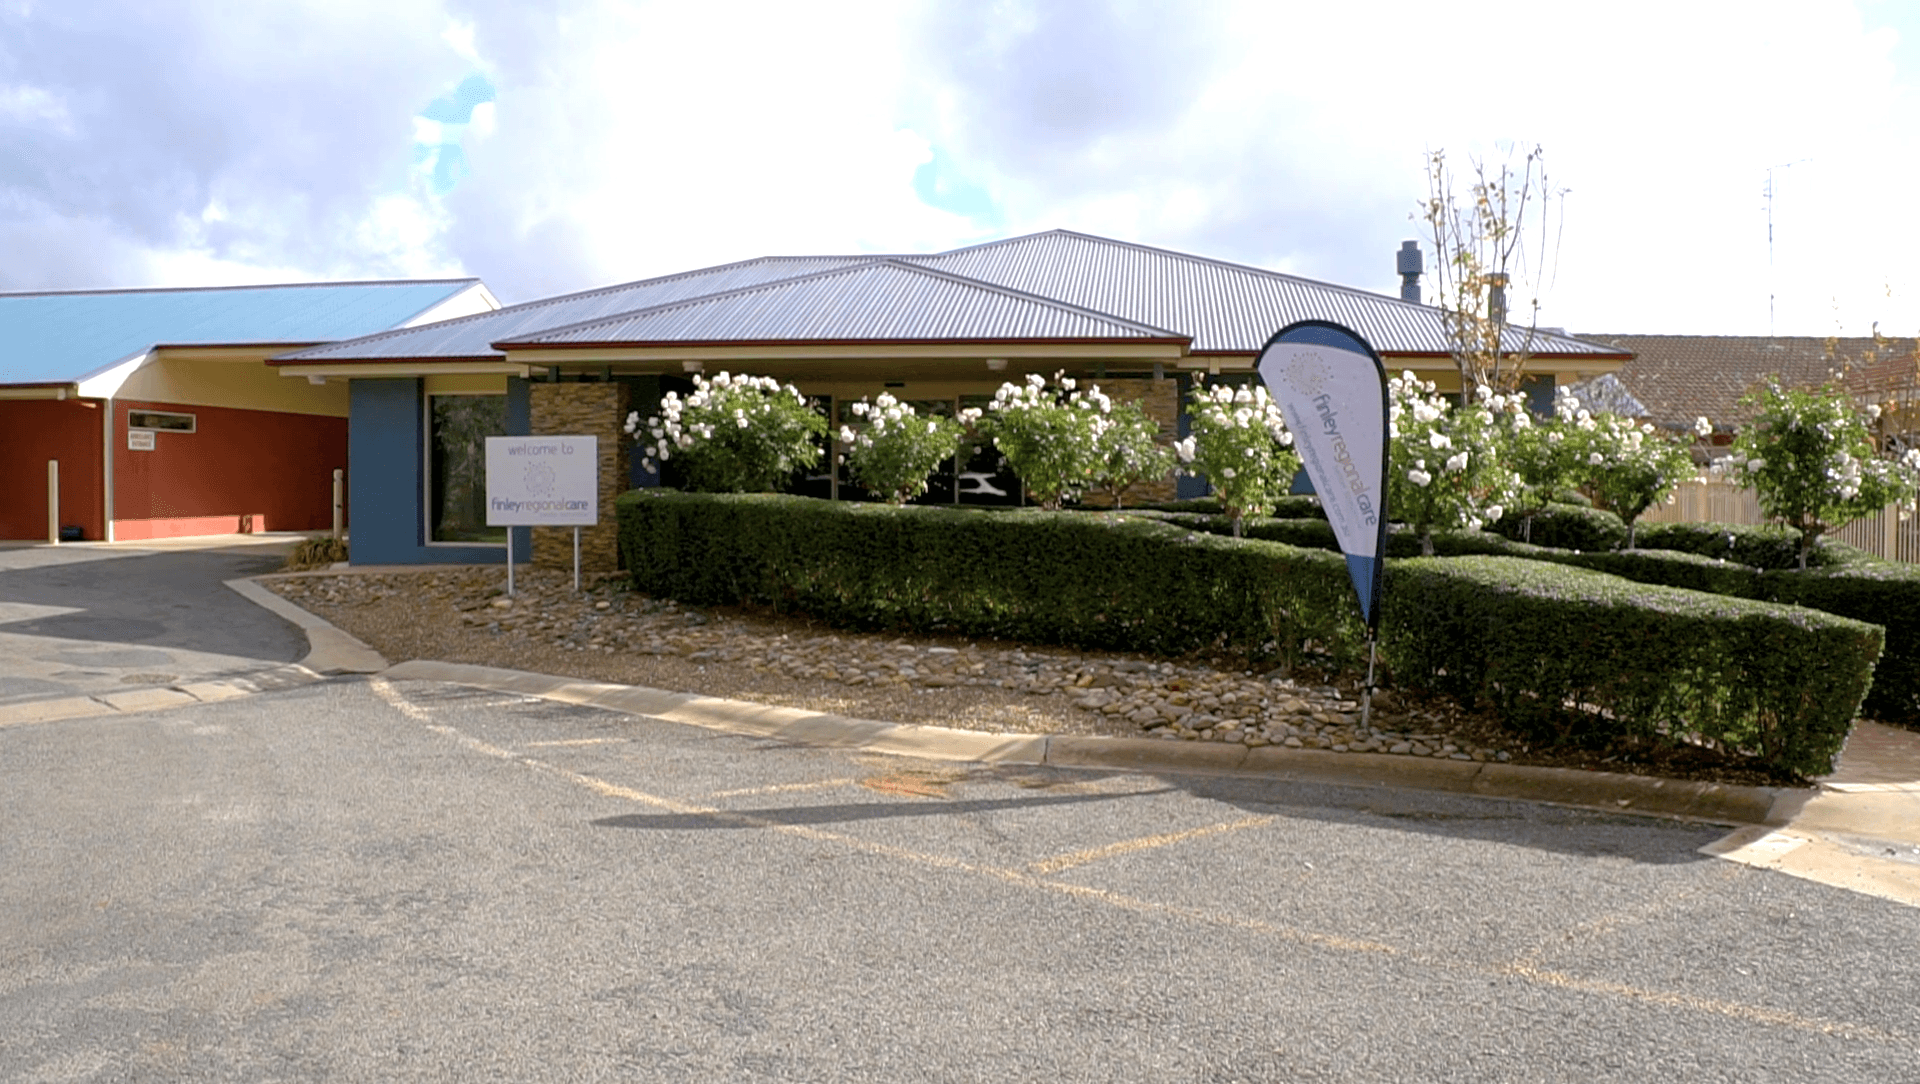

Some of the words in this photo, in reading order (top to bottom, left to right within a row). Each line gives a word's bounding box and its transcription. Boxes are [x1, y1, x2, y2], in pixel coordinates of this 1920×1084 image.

[508, 443, 557, 456] welcome
[561, 442, 574, 456] to
[1312, 393, 1377, 526] finleyregionalcare
[491, 497, 588, 513] finleyregionalcare
